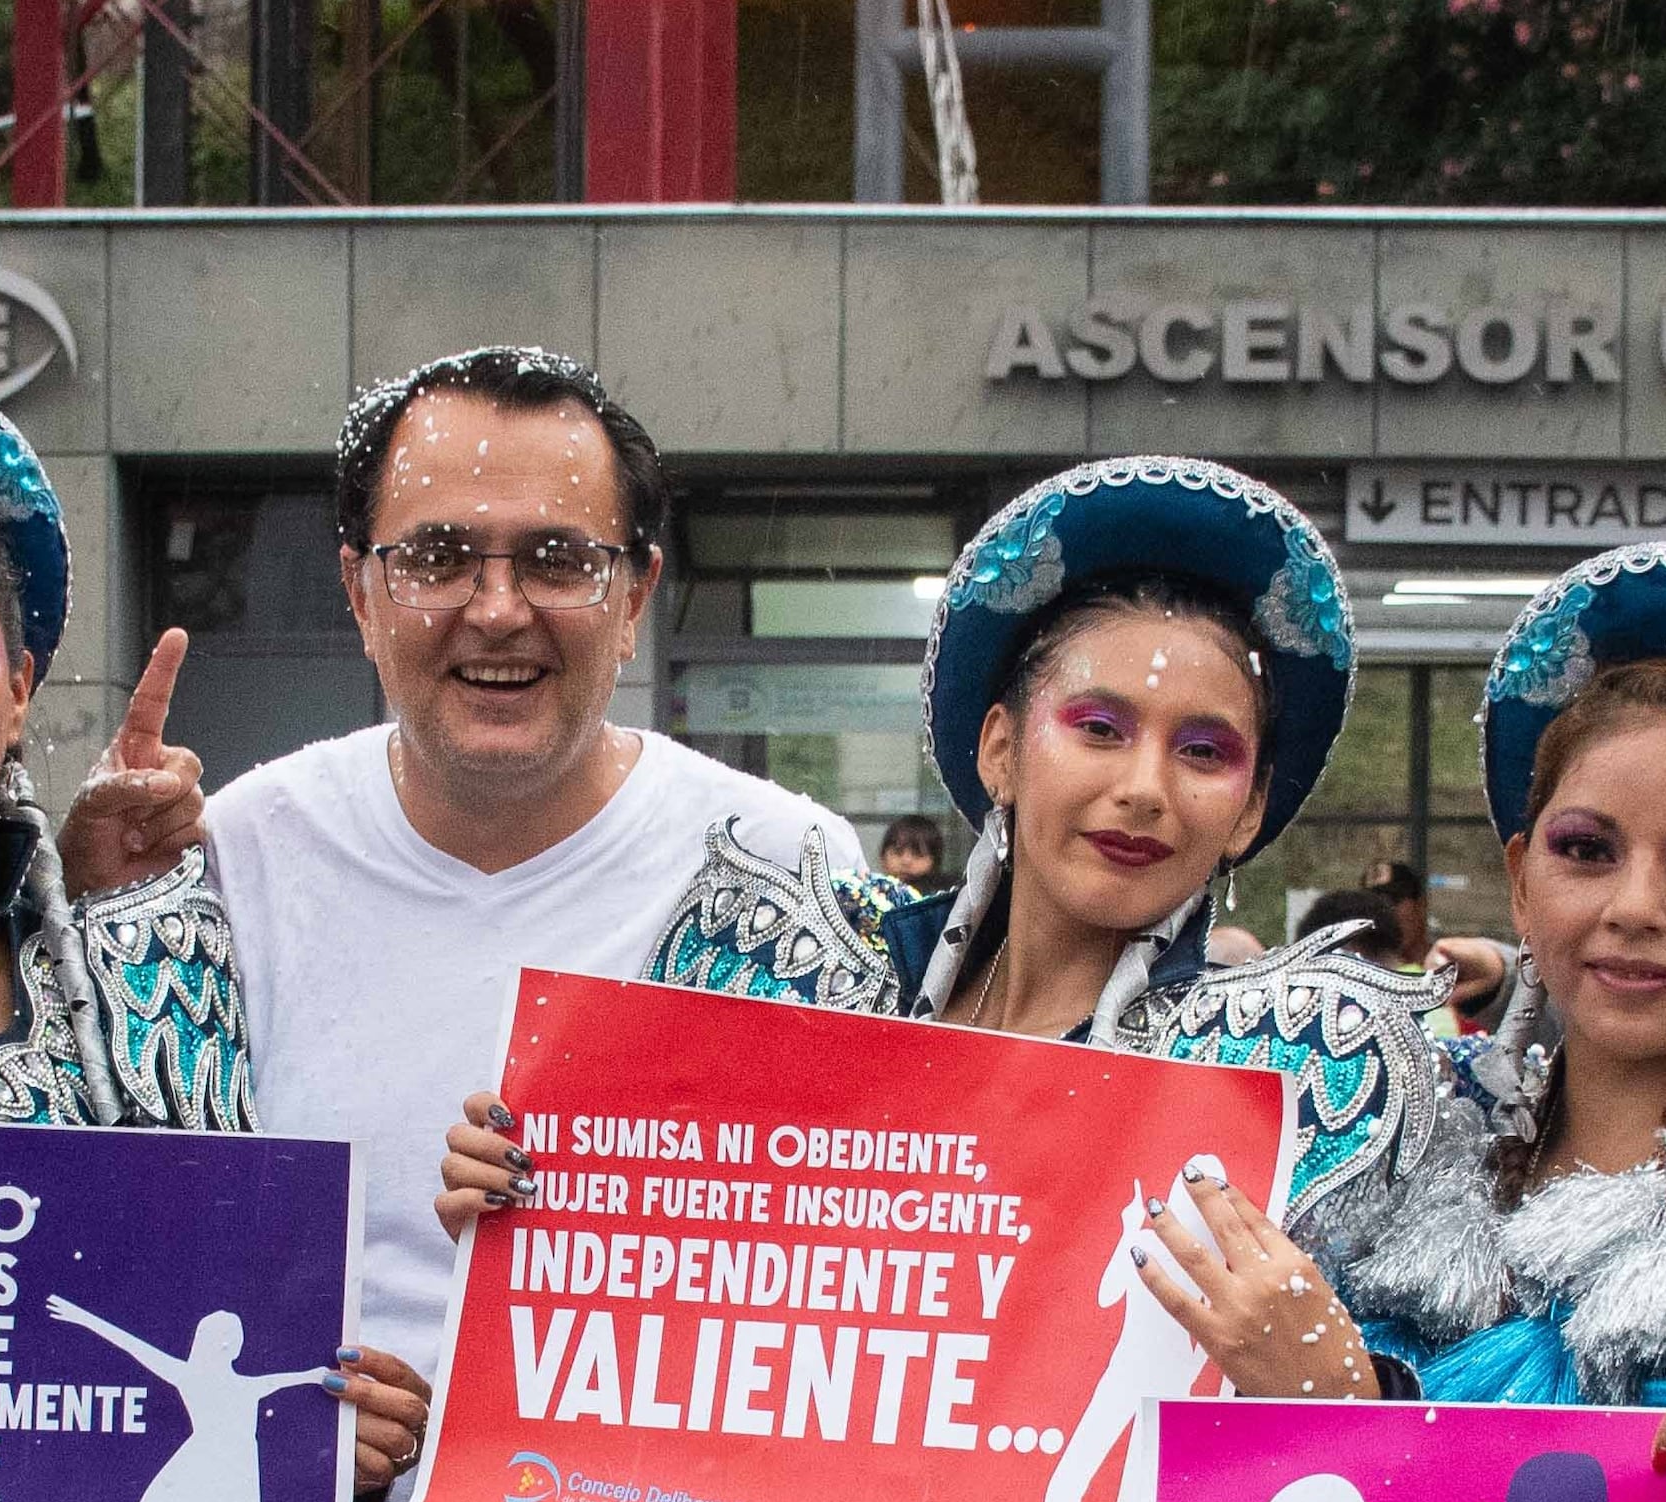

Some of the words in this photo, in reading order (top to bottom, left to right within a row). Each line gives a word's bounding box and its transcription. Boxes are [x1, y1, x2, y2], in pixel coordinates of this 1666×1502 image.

[985, 302, 1620, 384] ASCENSOR
[522, 1113, 558, 1153] NI
[572, 1116, 703, 1161] SUMISA
[717, 1123, 754, 1164] NI
[768, 1126, 987, 1183] OBEDIENTE,
[643, 1177, 772, 1223] FUERTE
[784, 1185, 1031, 1244] INSURGENTE,
[510, 1228, 955, 1317] INDEPENDIENTE
[978, 1254, 1016, 1319] Y
[510, 1305, 1065, 1456] VALIENTE...
[568, 1472, 641, 1502] Concejo
